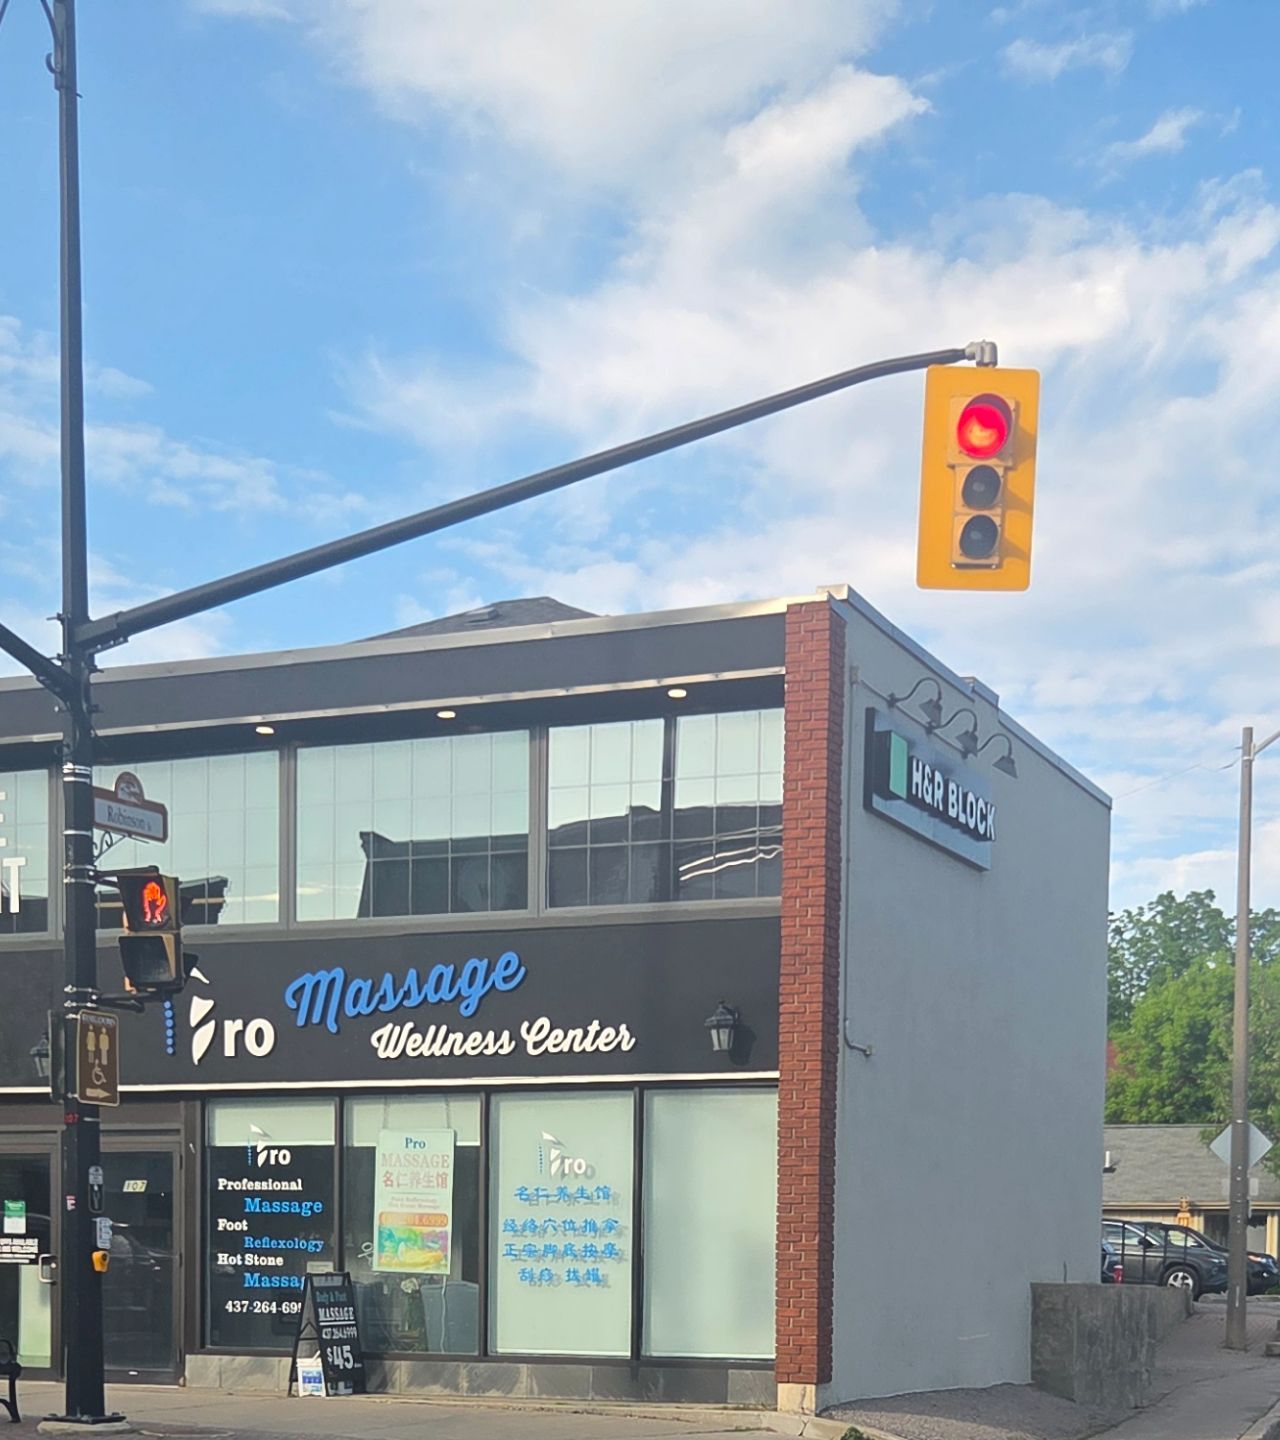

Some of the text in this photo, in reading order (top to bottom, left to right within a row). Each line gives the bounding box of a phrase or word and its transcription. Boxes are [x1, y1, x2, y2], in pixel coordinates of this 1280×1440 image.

[912, 757, 995, 840] H&R BLOCK
[284, 951, 527, 1034] Massage
[371, 1016, 636, 1059] Wellness Center
[405, 1137, 426, 1149] Pro
[381, 1153, 450, 1169] MASSAGE
[217, 1178, 303, 1190] Professional
[514, 1185, 611, 1201] 名仁养生馆
[244, 1198, 323, 1217] Massage
[217, 1218, 248, 1231] Foot
[244, 1237, 324, 1252] Reflexology
[217, 1253, 284, 1266] Hot Stone
[244, 1273, 306, 1291] Massa
